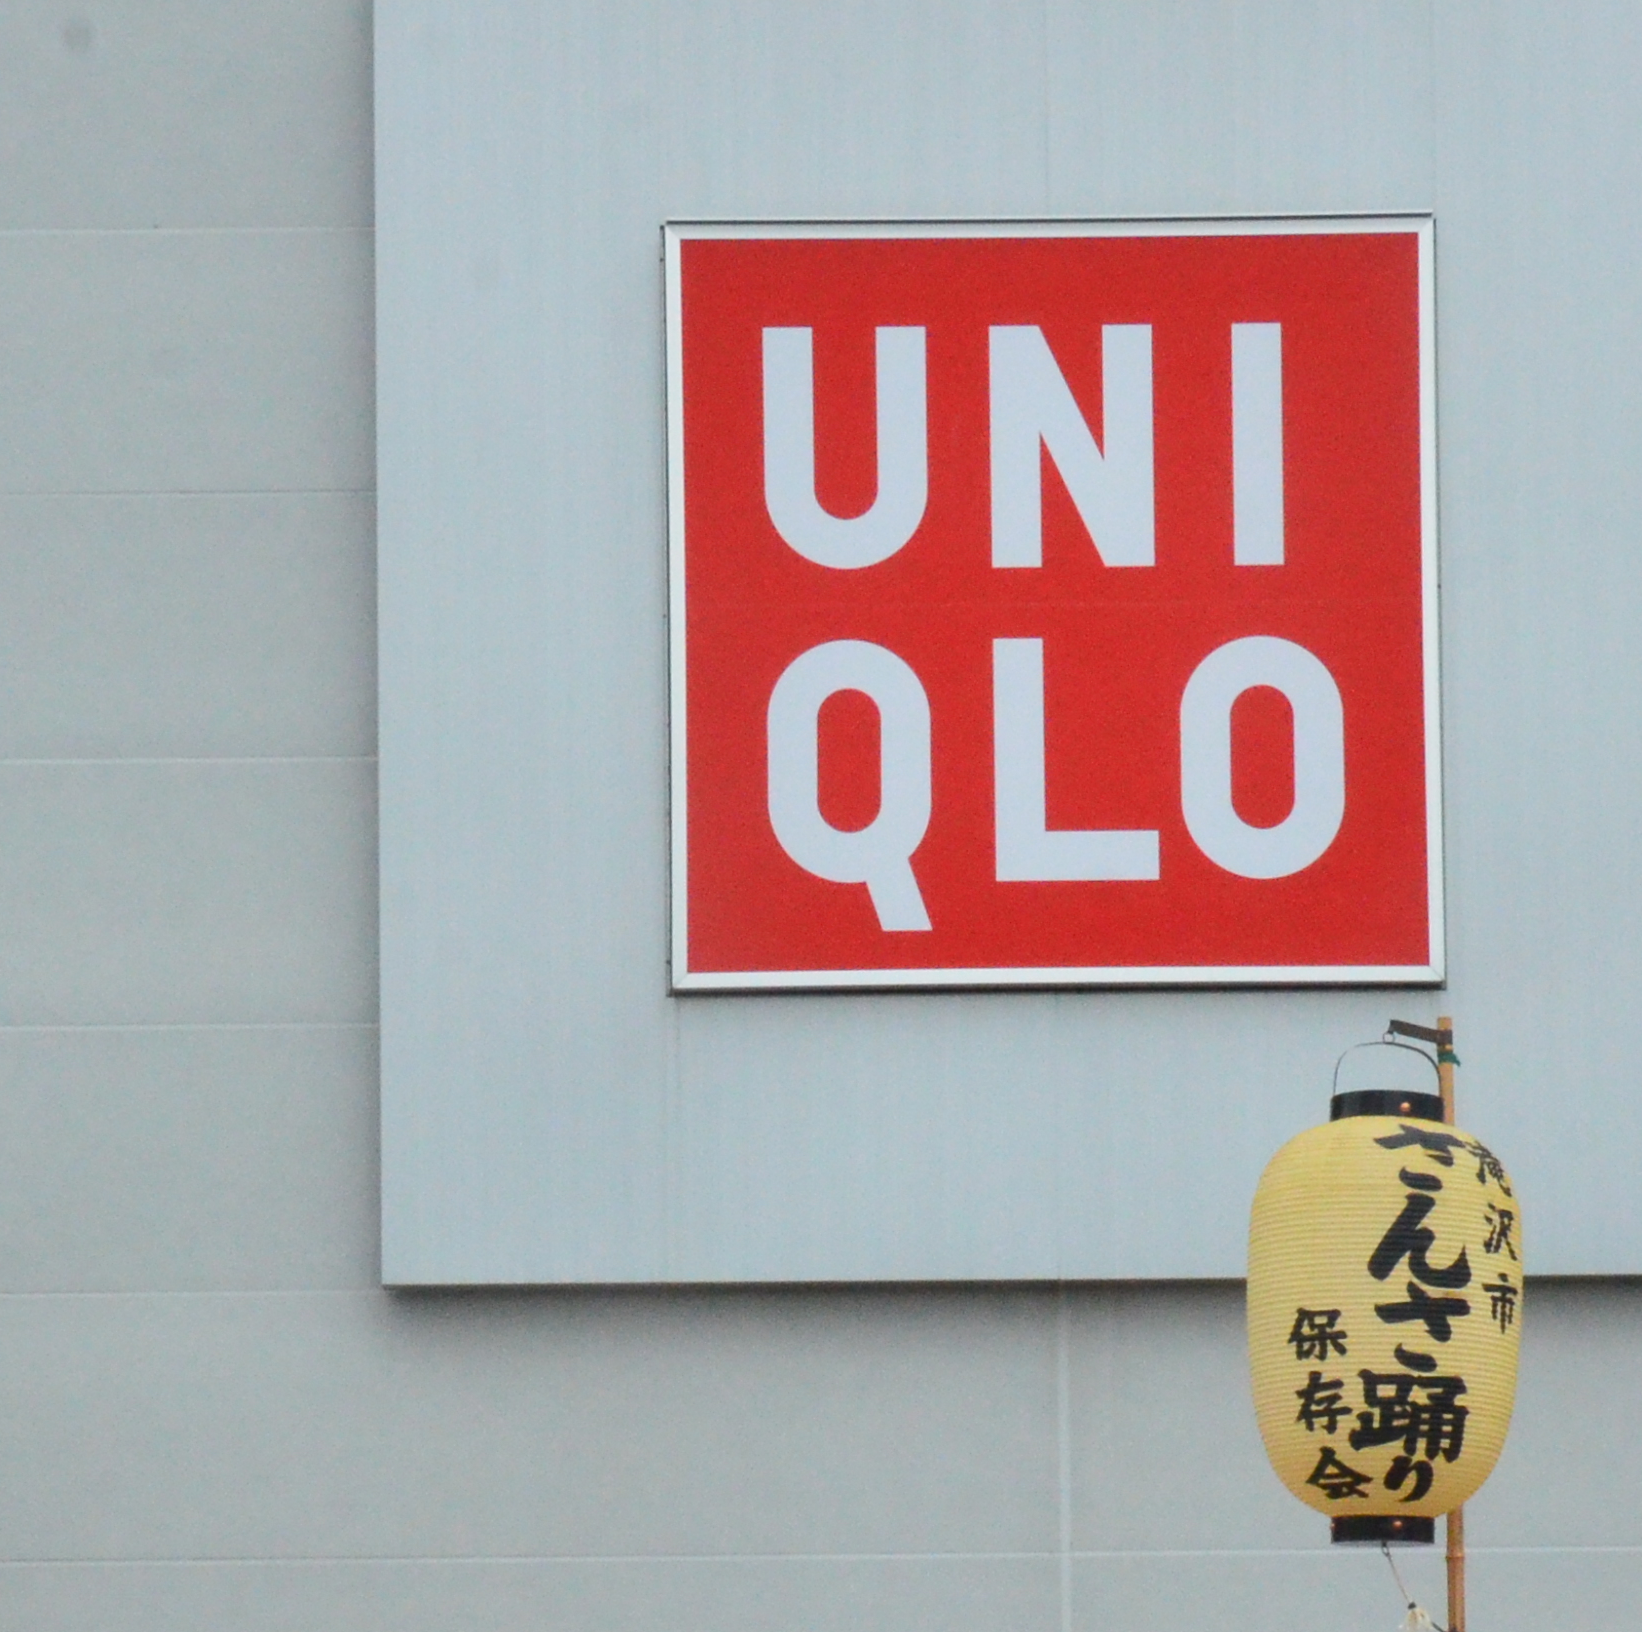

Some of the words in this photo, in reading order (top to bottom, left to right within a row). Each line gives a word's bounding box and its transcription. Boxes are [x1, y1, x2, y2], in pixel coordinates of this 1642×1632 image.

[762, 323, 1285, 569] UNI
[767, 636, 1345, 931] QLO
[1288, 1307, 1373, 1499] 保存会
[1349, 1123, 1471, 1502] さんさ踊り
